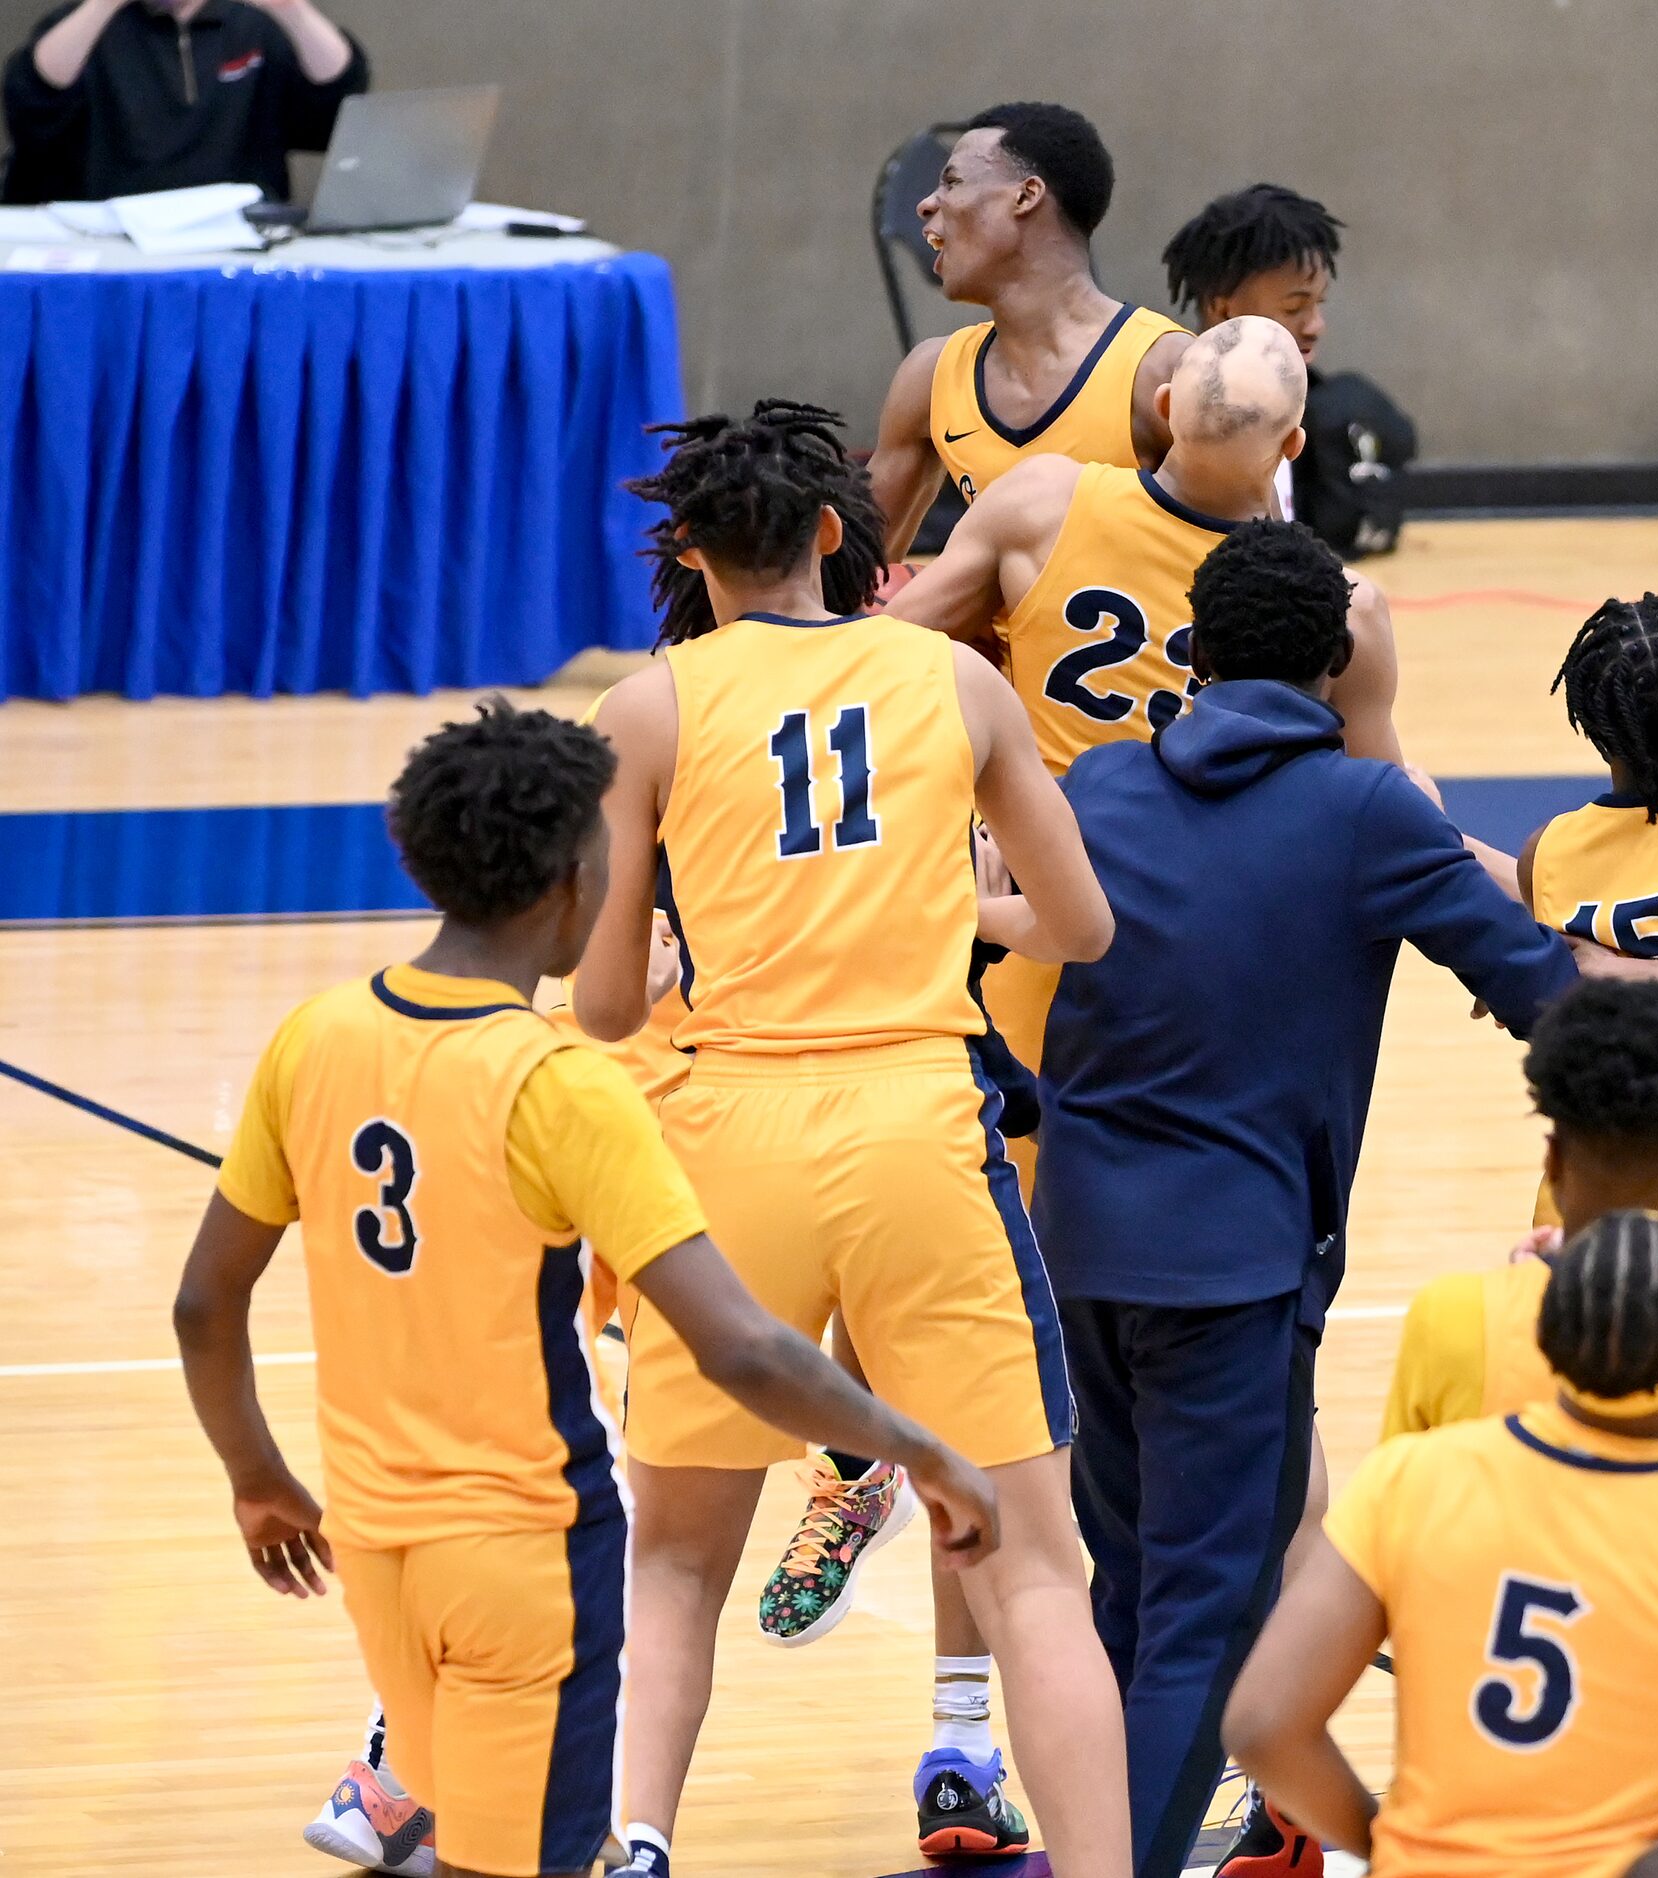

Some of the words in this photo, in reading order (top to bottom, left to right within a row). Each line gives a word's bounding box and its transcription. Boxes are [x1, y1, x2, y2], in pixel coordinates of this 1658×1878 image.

[767, 702, 882, 861] 11
[350, 1117, 421, 1277] 3
[1472, 1570, 1591, 1752] 5
